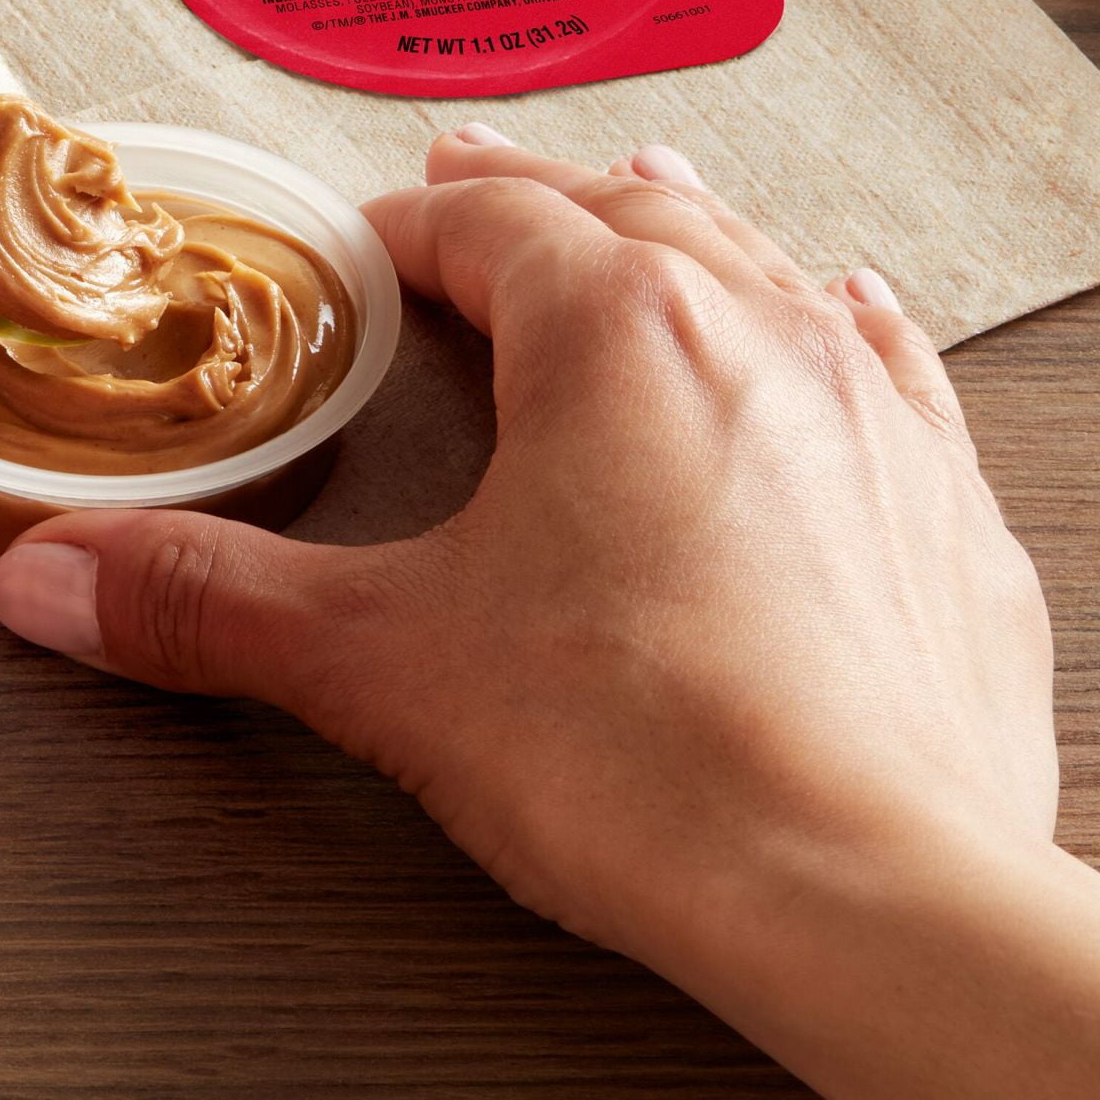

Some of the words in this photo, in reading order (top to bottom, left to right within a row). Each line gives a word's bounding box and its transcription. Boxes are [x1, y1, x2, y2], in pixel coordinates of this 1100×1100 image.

[368, 13, 388, 23] THE
[415, 3, 466, 18] SMUCKER
[397, 36, 432, 54] NET
[437, 37, 465, 55] WT
[471, 34, 497, 53] 1.1
[500, 32, 526, 51] OZ
